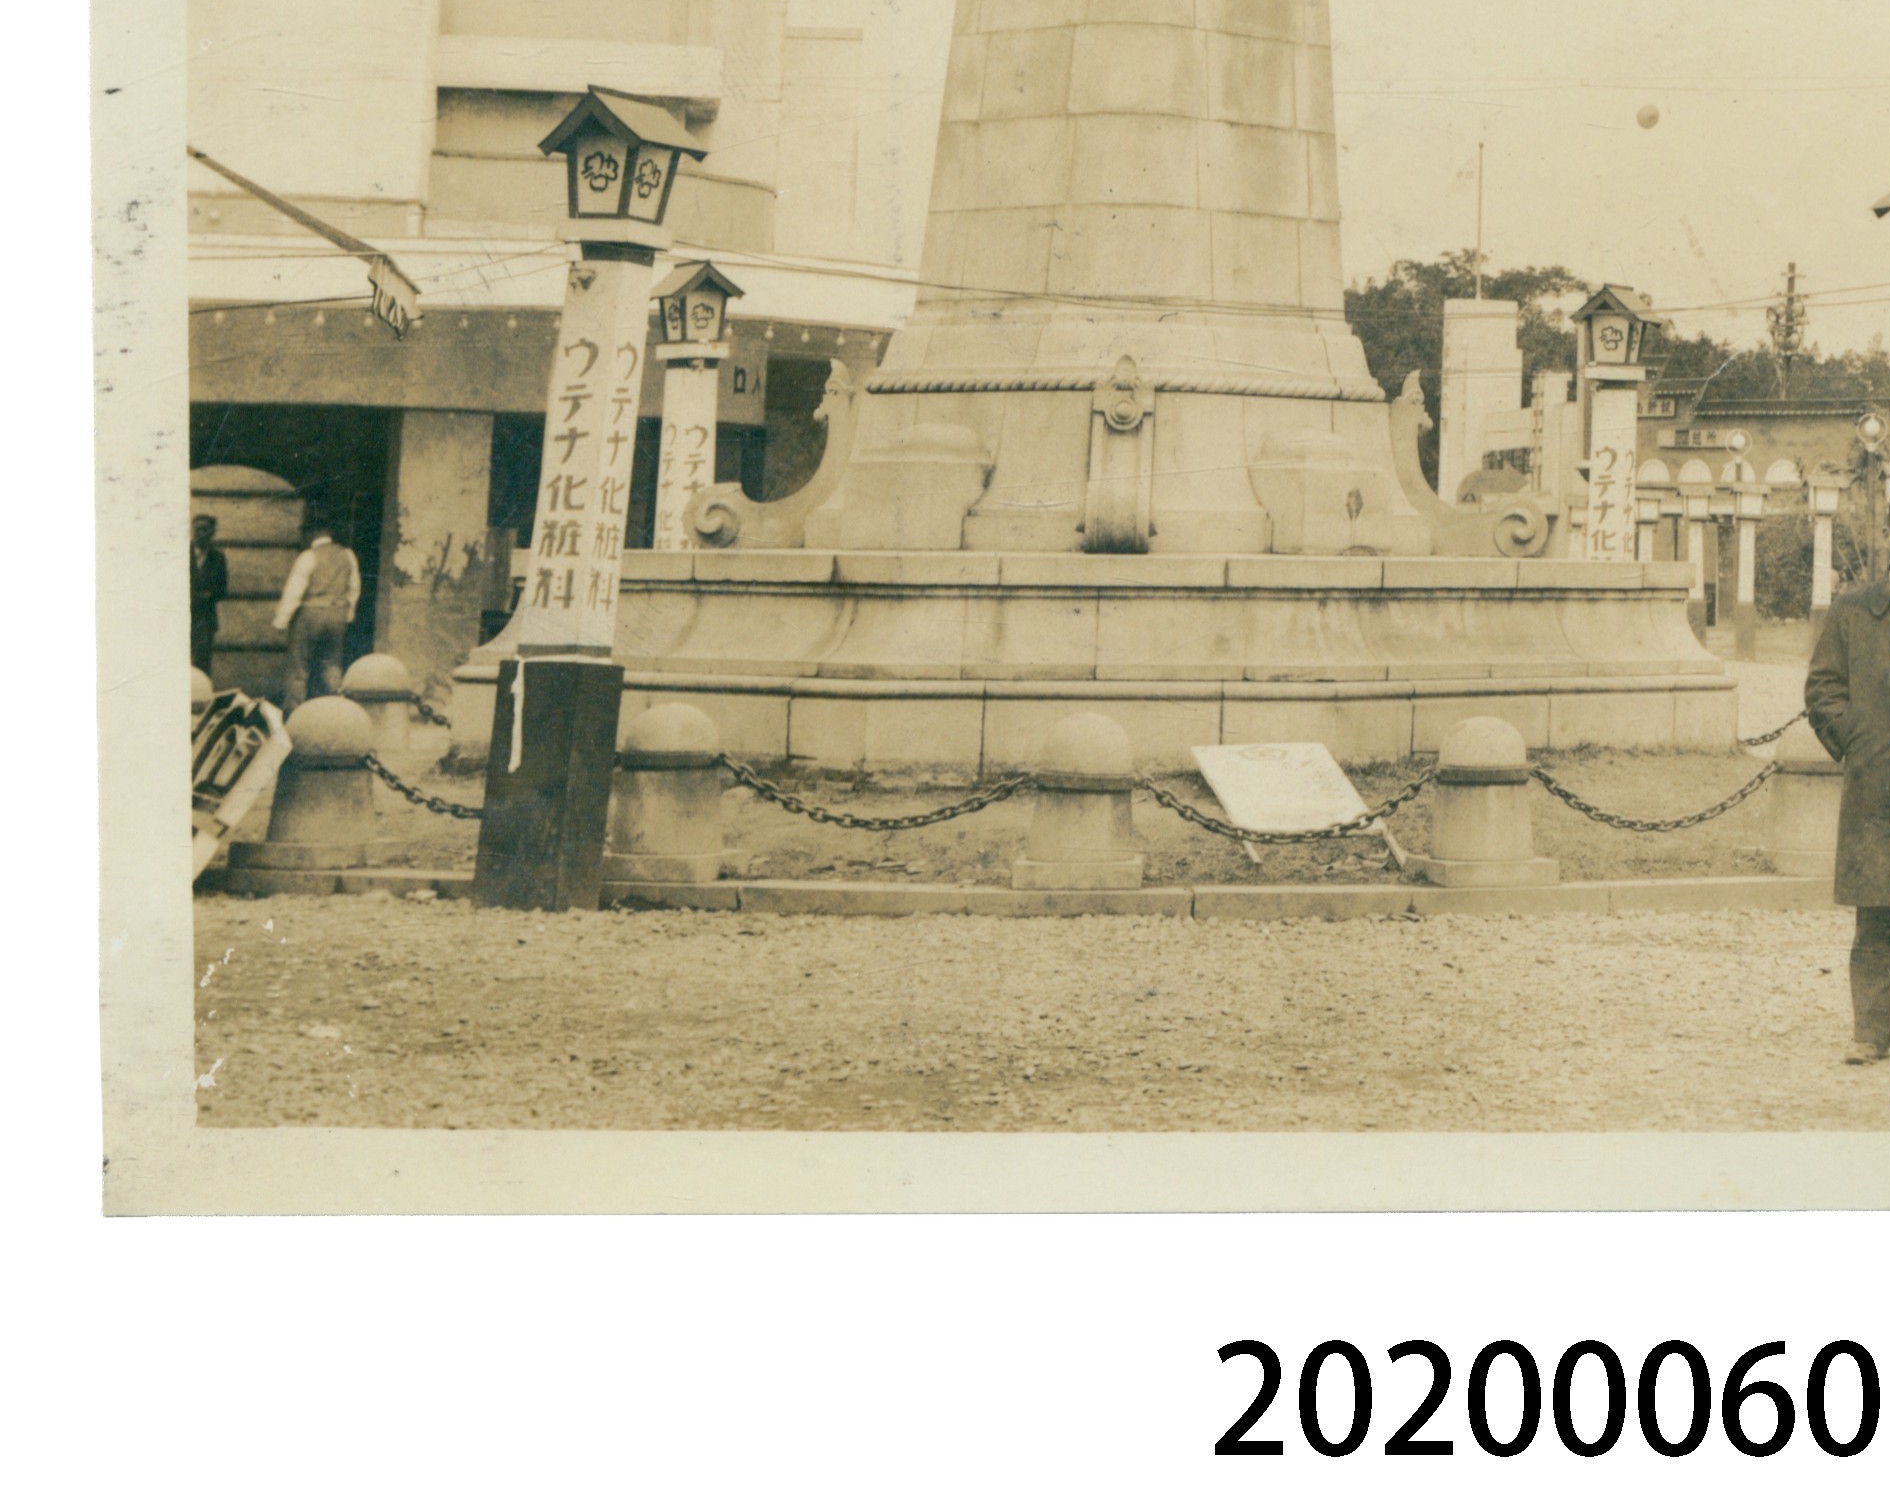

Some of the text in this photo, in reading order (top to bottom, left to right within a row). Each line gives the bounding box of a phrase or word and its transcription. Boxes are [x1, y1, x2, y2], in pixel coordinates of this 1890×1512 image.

[532, 337, 600, 610] ウテナ化粧料
[586, 341, 639, 613] ウテナ化粧料
